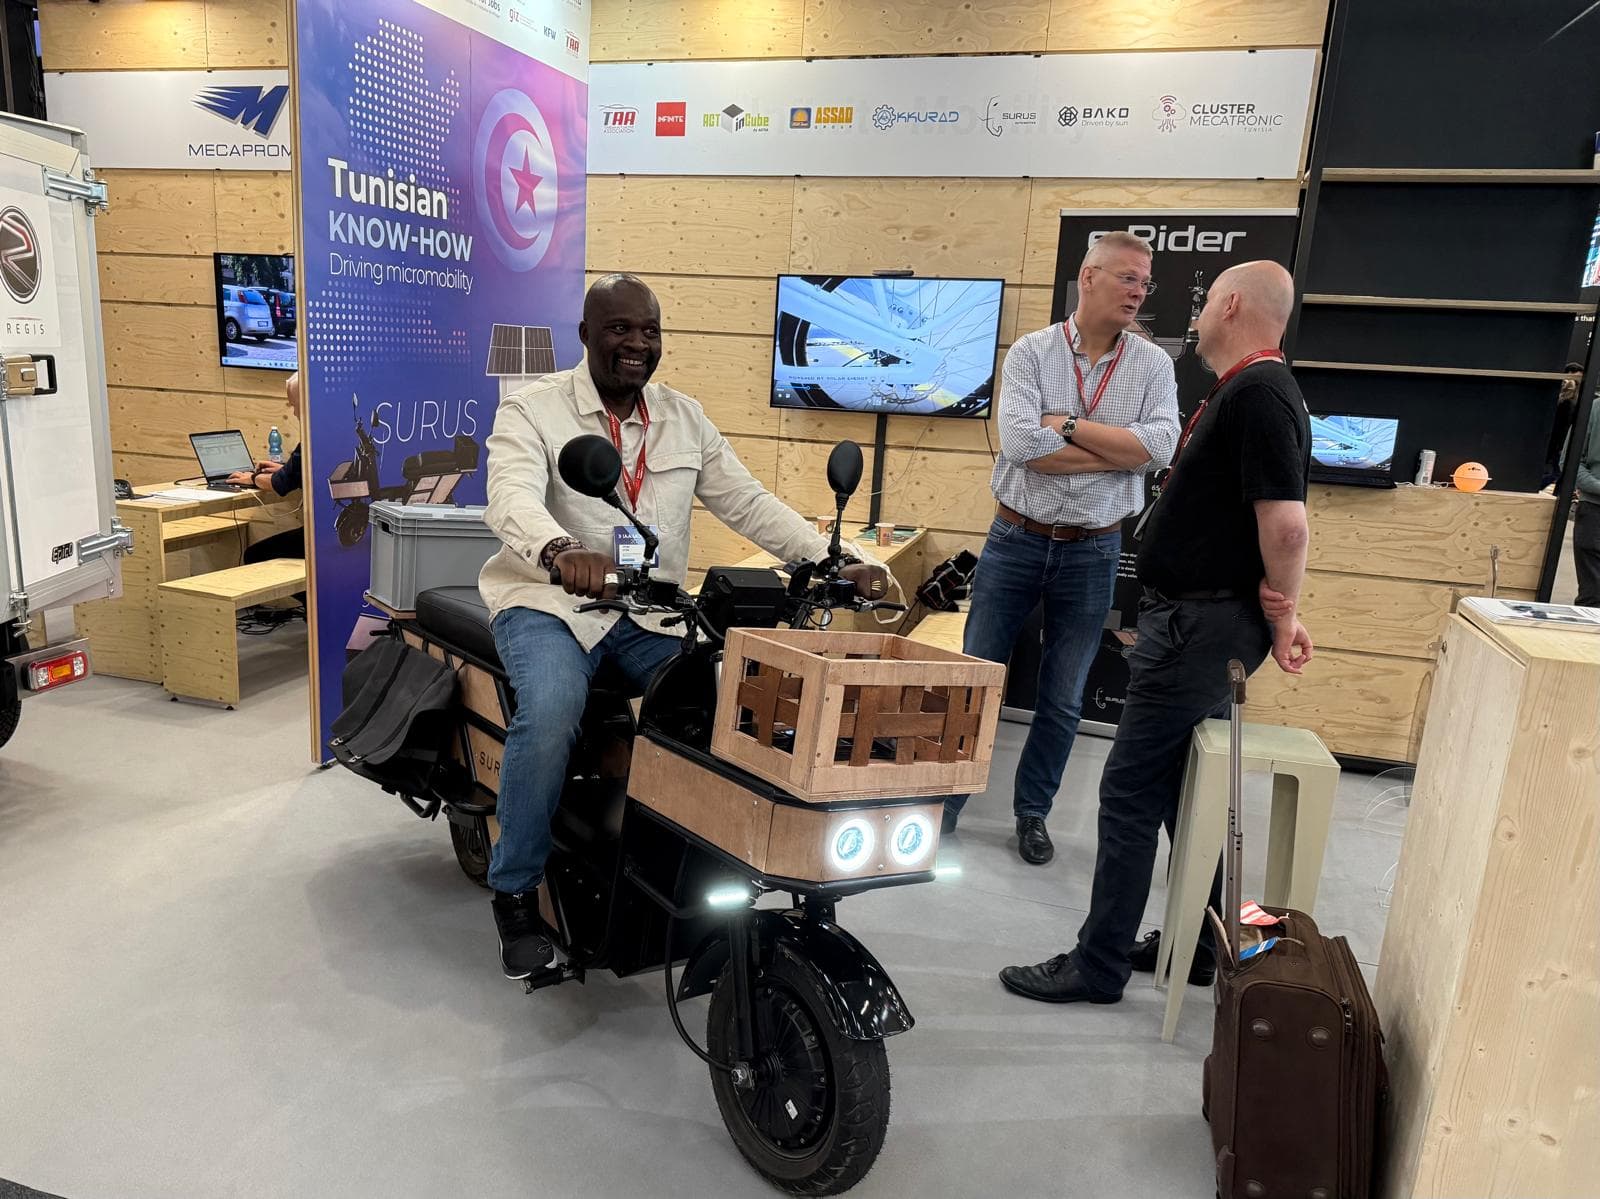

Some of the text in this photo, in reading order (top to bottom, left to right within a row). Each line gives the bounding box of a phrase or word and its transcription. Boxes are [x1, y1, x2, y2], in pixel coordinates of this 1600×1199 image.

[510, 8, 519, 22] giz
[1083, 107, 1129, 118] BAKO
[1192, 103, 1255, 114] CLUSTER
[603, 111, 636, 125] TAA
[1002, 112, 1036, 120] SURUS
[1190, 115, 1283, 126] MECATRONIC
[1104, 120, 1114, 128] by
[328, 157, 448, 219] Tunisian
[329, 210, 472, 262] KNOW-HOW
[330, 252, 473, 295] Driving micromobility
[6, 322, 45, 335] REGIS
[373, 399, 478, 444] SURUS
